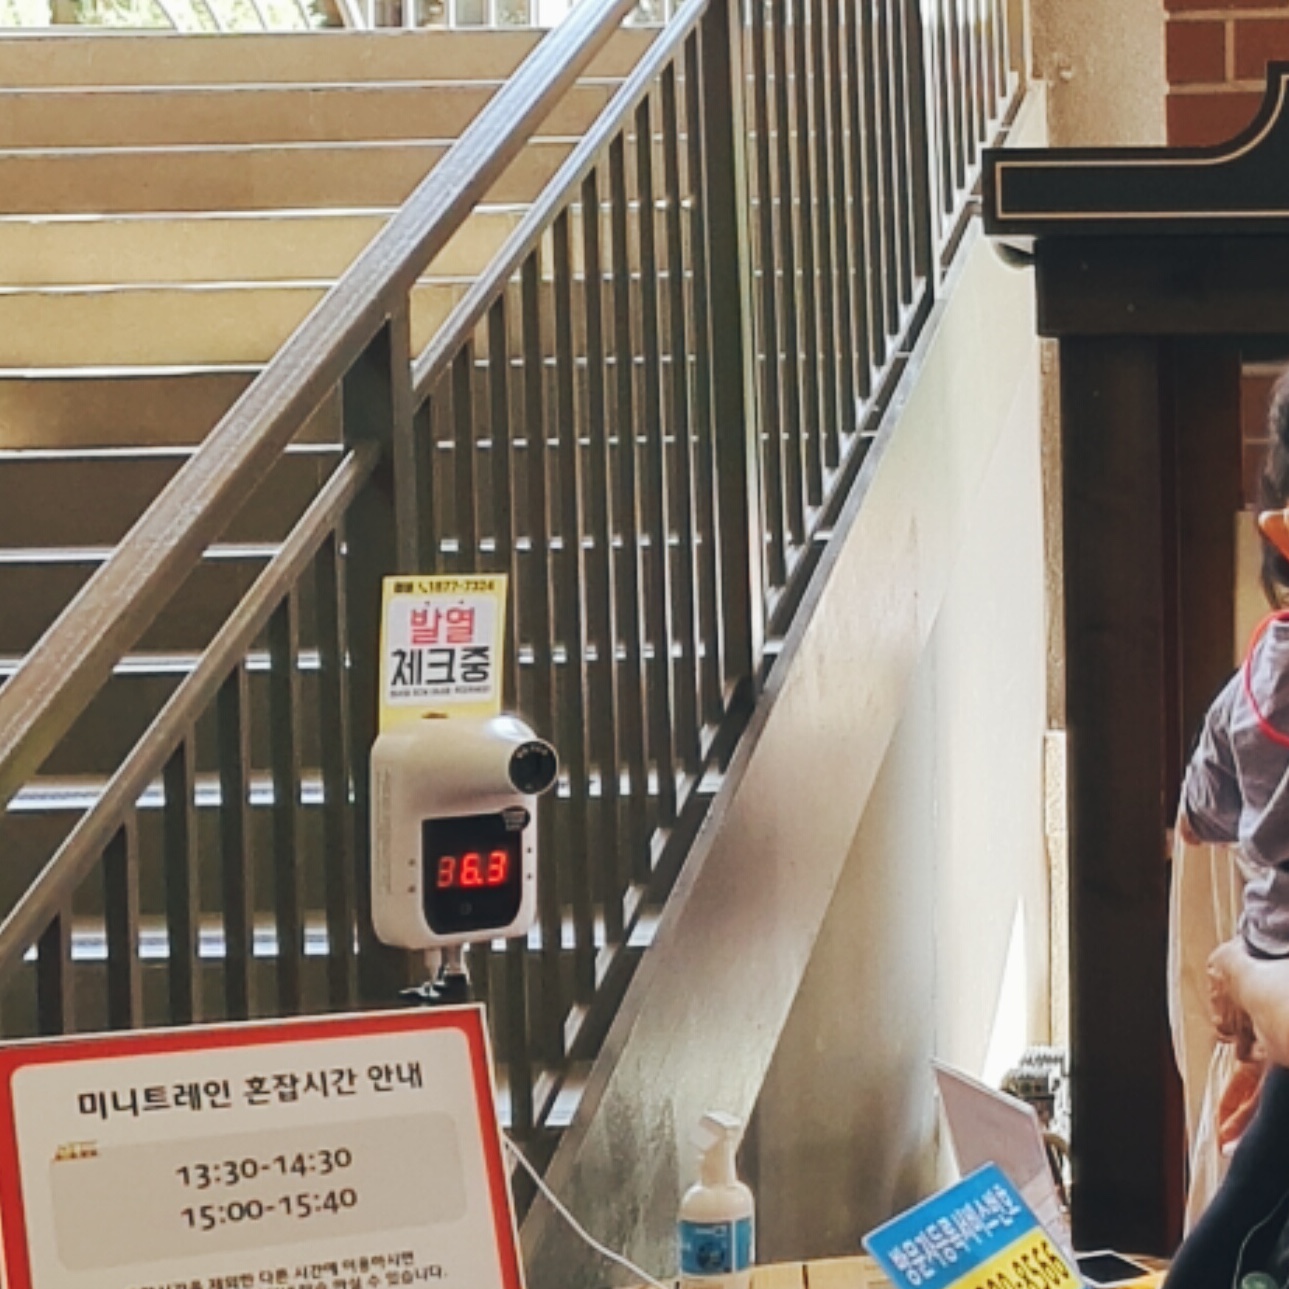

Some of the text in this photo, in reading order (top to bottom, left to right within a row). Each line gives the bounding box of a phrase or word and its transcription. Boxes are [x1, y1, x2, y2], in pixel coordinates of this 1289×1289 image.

[411, 606, 475, 646] 발열
[391, 645, 491, 687] 체크중
[437, 850, 509, 888] 36.3
[78, 1060, 424, 1120] 미니트레인 혼잡시간 안내
[175, 1148, 353, 1190] 13:30-14:30
[180, 1187, 358, 1232] 15:00-15:40
